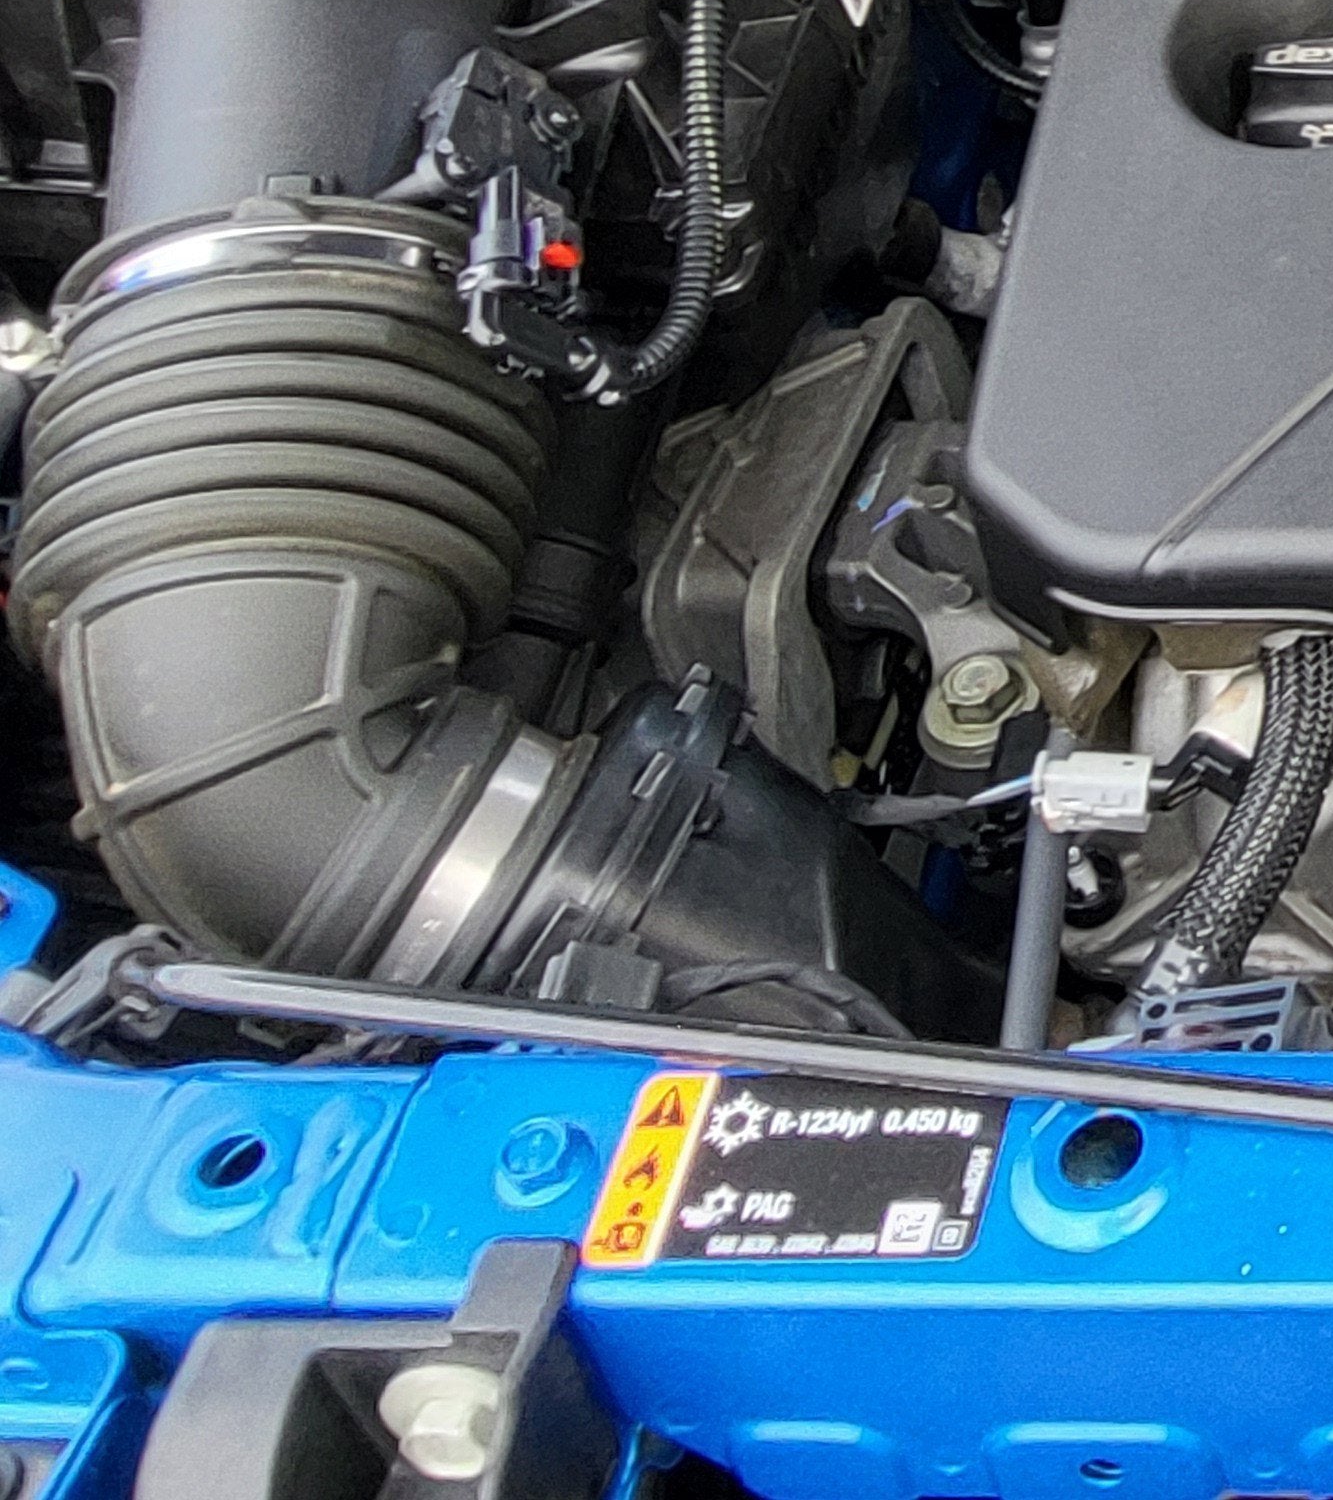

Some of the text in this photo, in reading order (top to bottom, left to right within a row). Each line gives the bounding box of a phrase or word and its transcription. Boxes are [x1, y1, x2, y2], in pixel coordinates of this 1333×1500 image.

[882, 1109, 947, 1134] 0.450
[947, 1109, 982, 1137] kg
[740, 1190, 794, 1222] PAG
